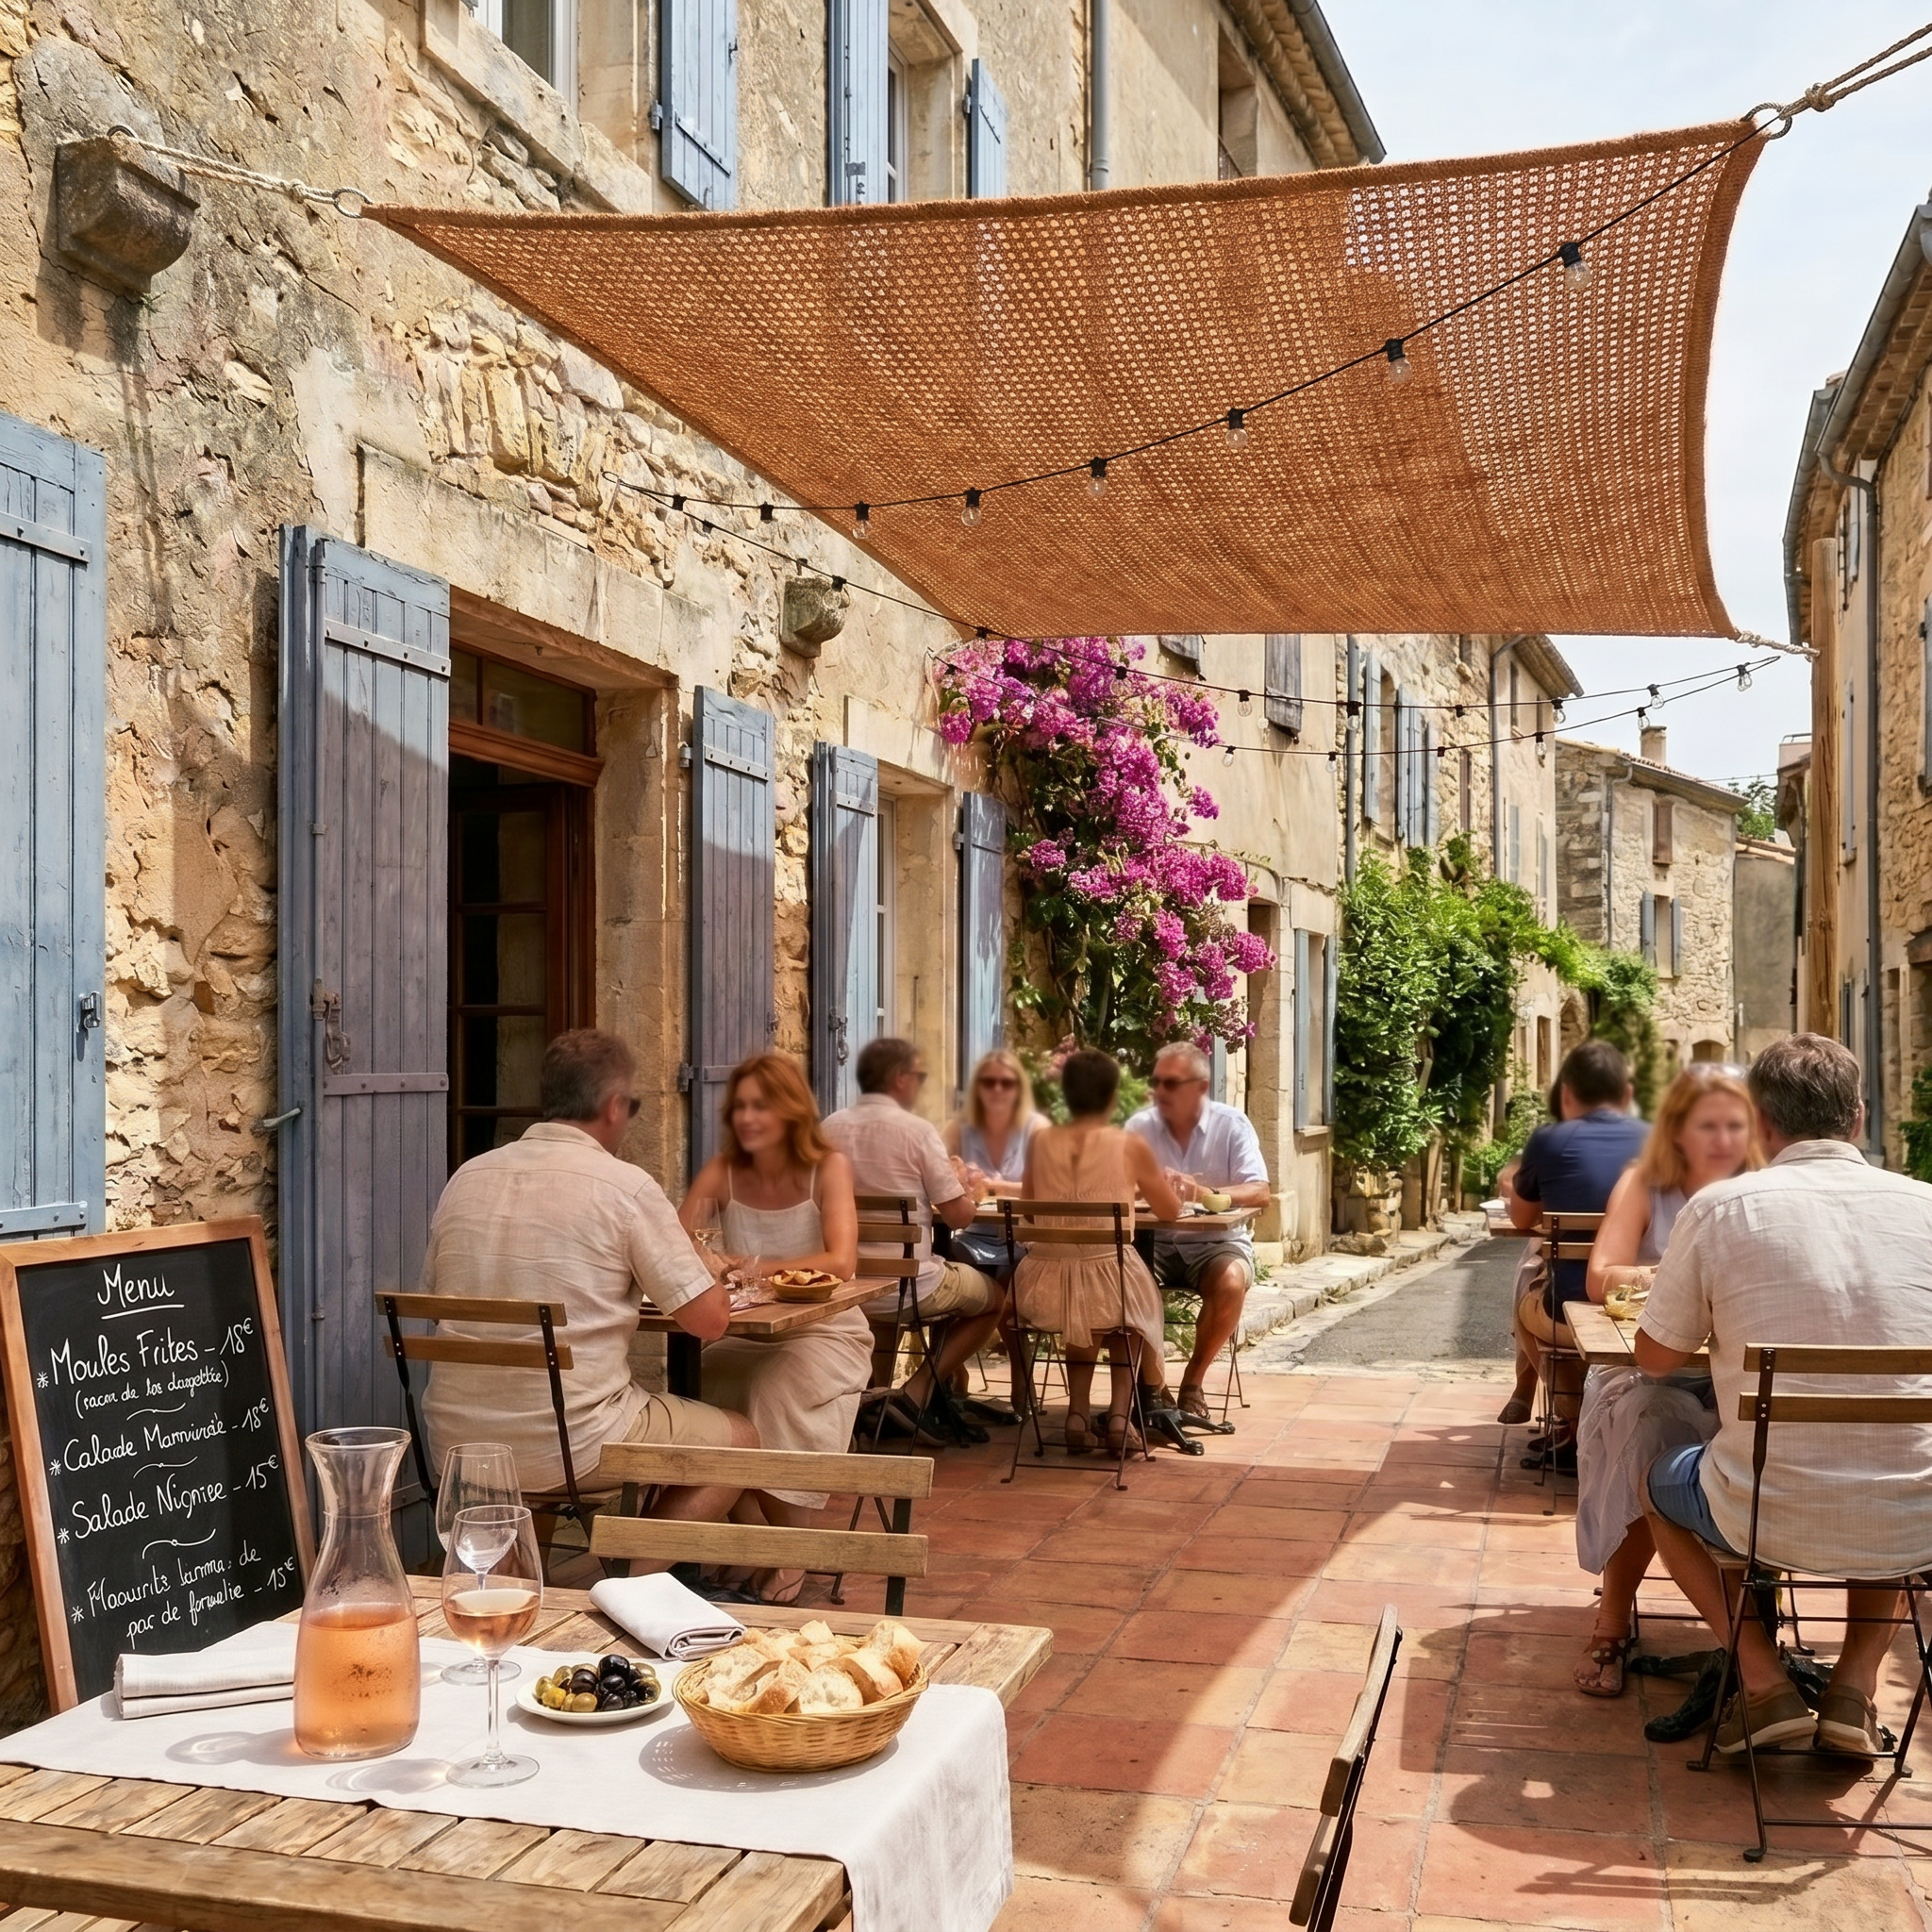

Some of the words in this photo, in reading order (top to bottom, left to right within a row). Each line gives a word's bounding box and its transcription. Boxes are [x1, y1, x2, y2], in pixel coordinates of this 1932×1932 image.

[96, 1262, 175, 1308] Menu
[50, 1334, 131, 1386] Moules
[136, 1326, 199, 1368] Frites
[72, 1491, 150, 1540] Salade
[239, 1540, 261, 1566] de
[161, 1600, 181, 1624] de
